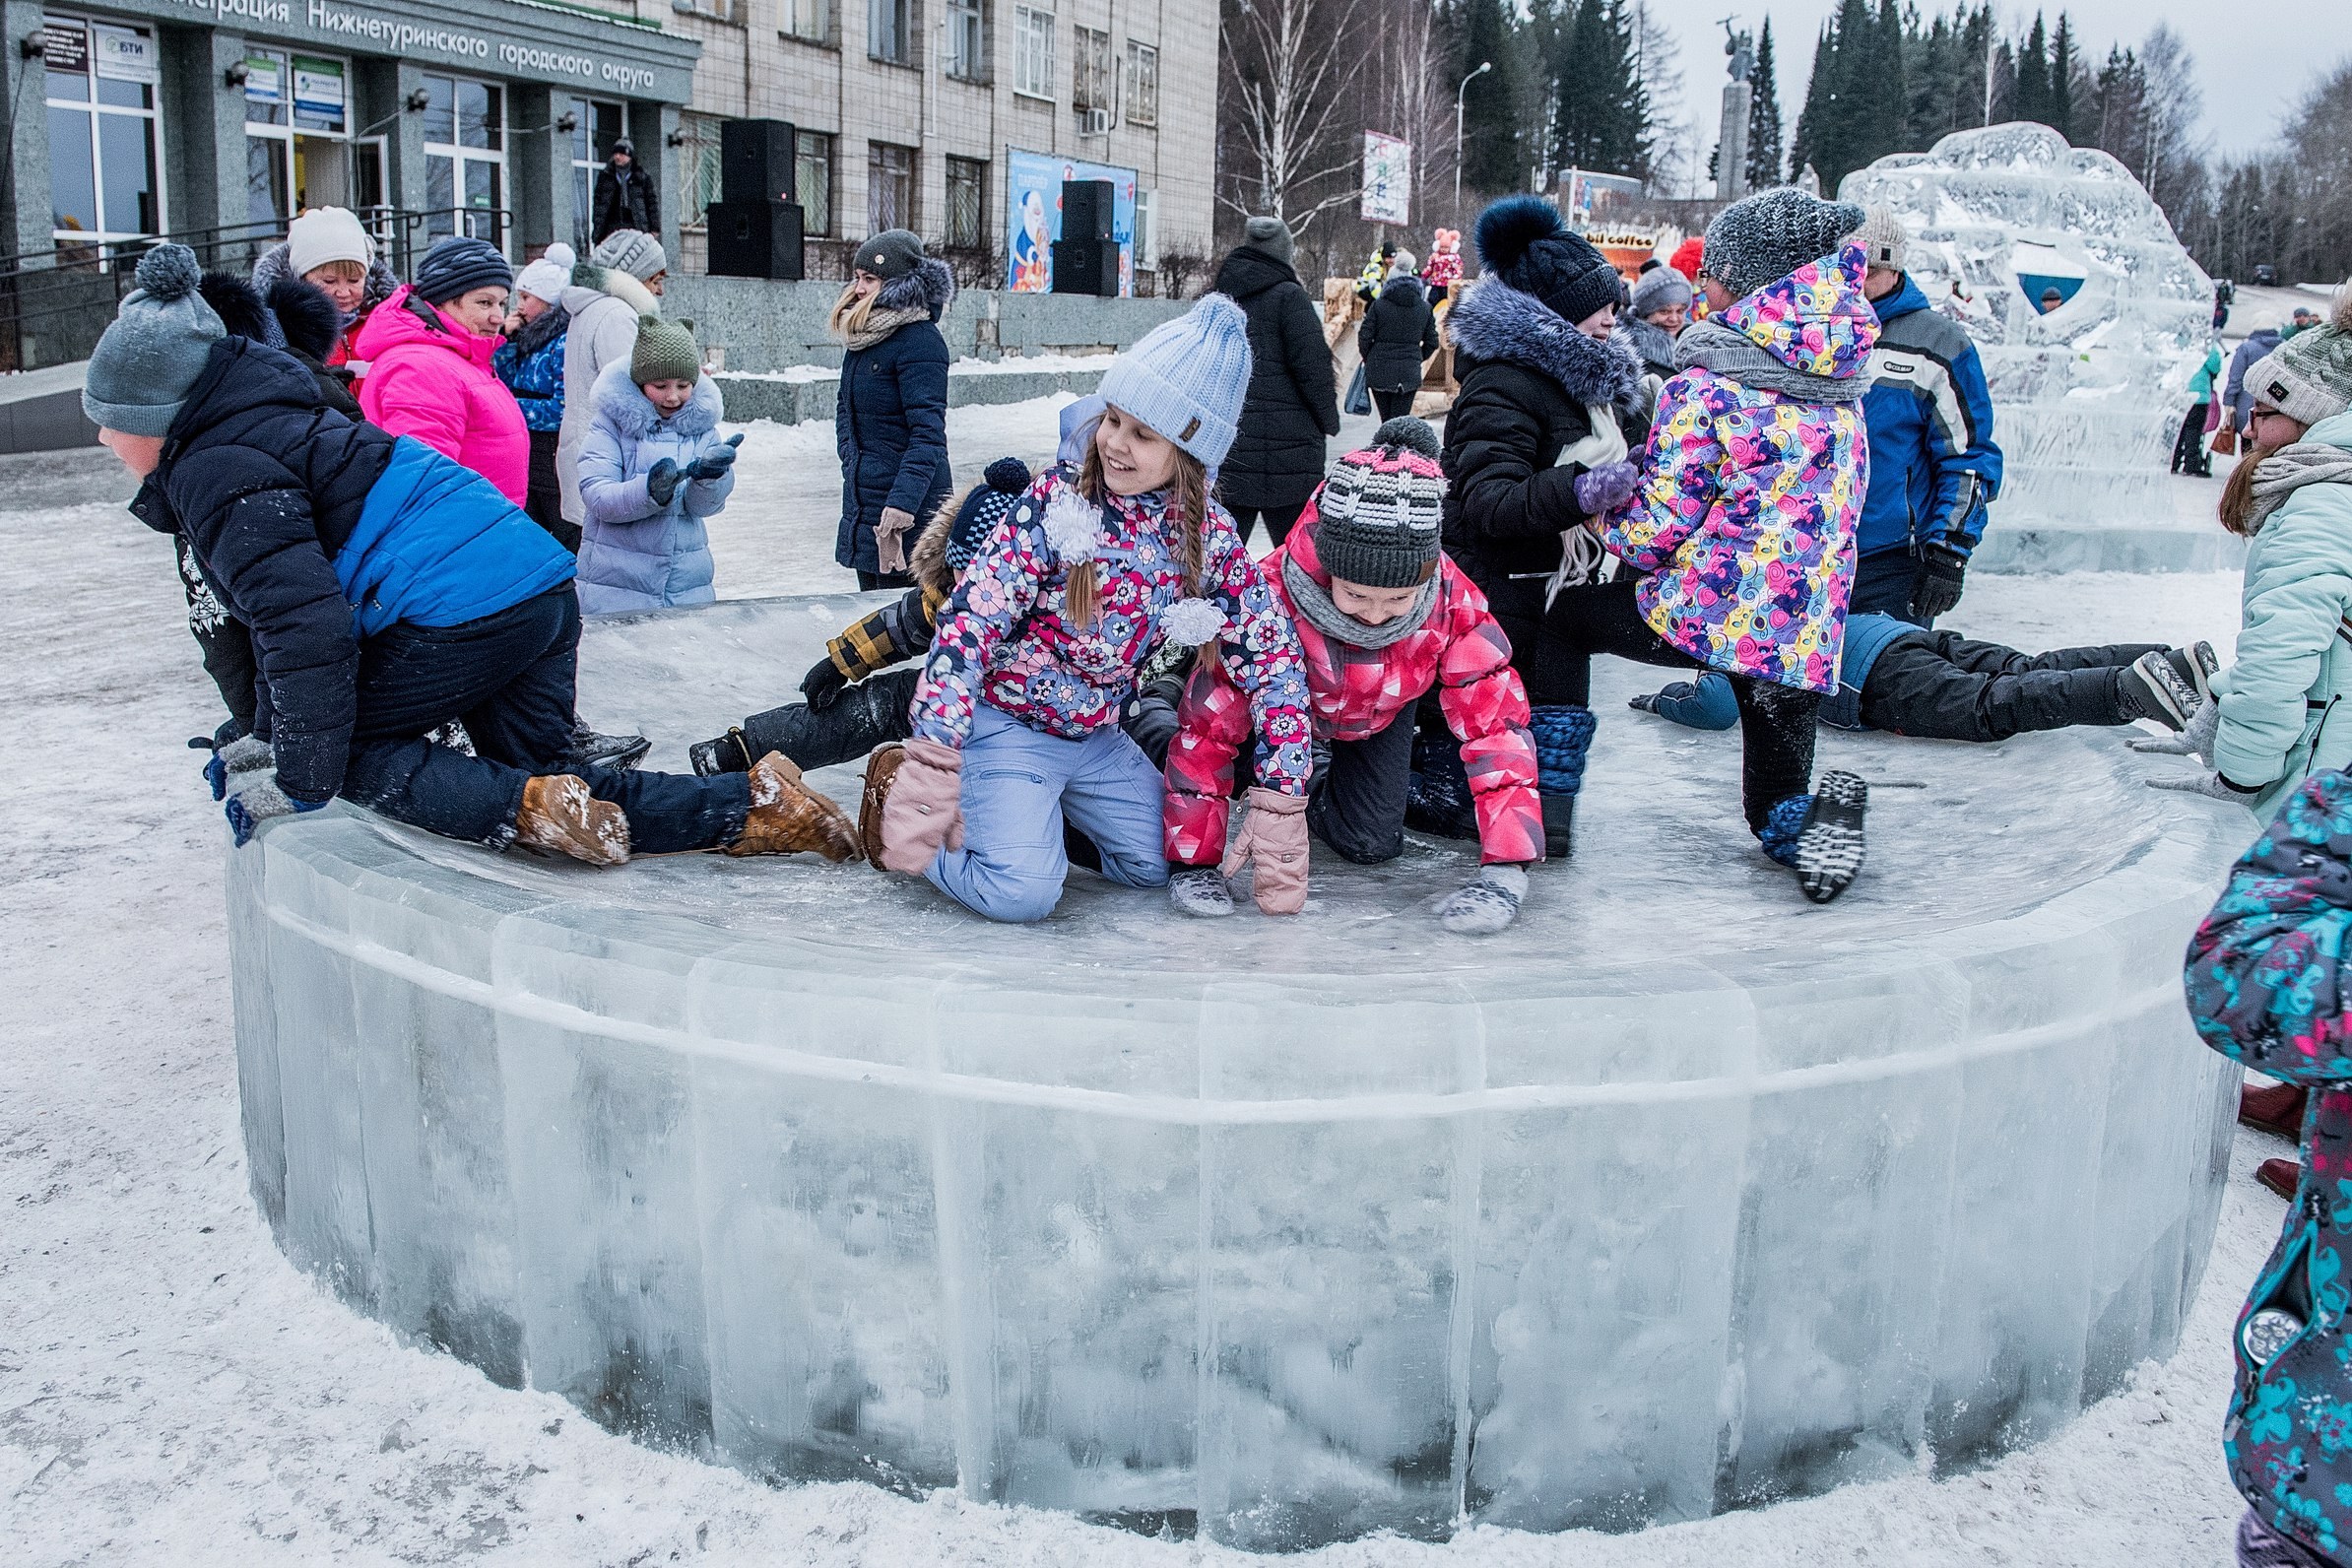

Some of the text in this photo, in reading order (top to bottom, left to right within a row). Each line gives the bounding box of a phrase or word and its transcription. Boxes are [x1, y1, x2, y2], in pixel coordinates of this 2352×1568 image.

[119, 41, 144, 54] БТИ
[307, 0, 489, 58] Нижнетуринского
[499, 42, 593, 77] городского
[601, 62, 654, 90] округа
[1587, 232, 1652, 245] bil coffee
